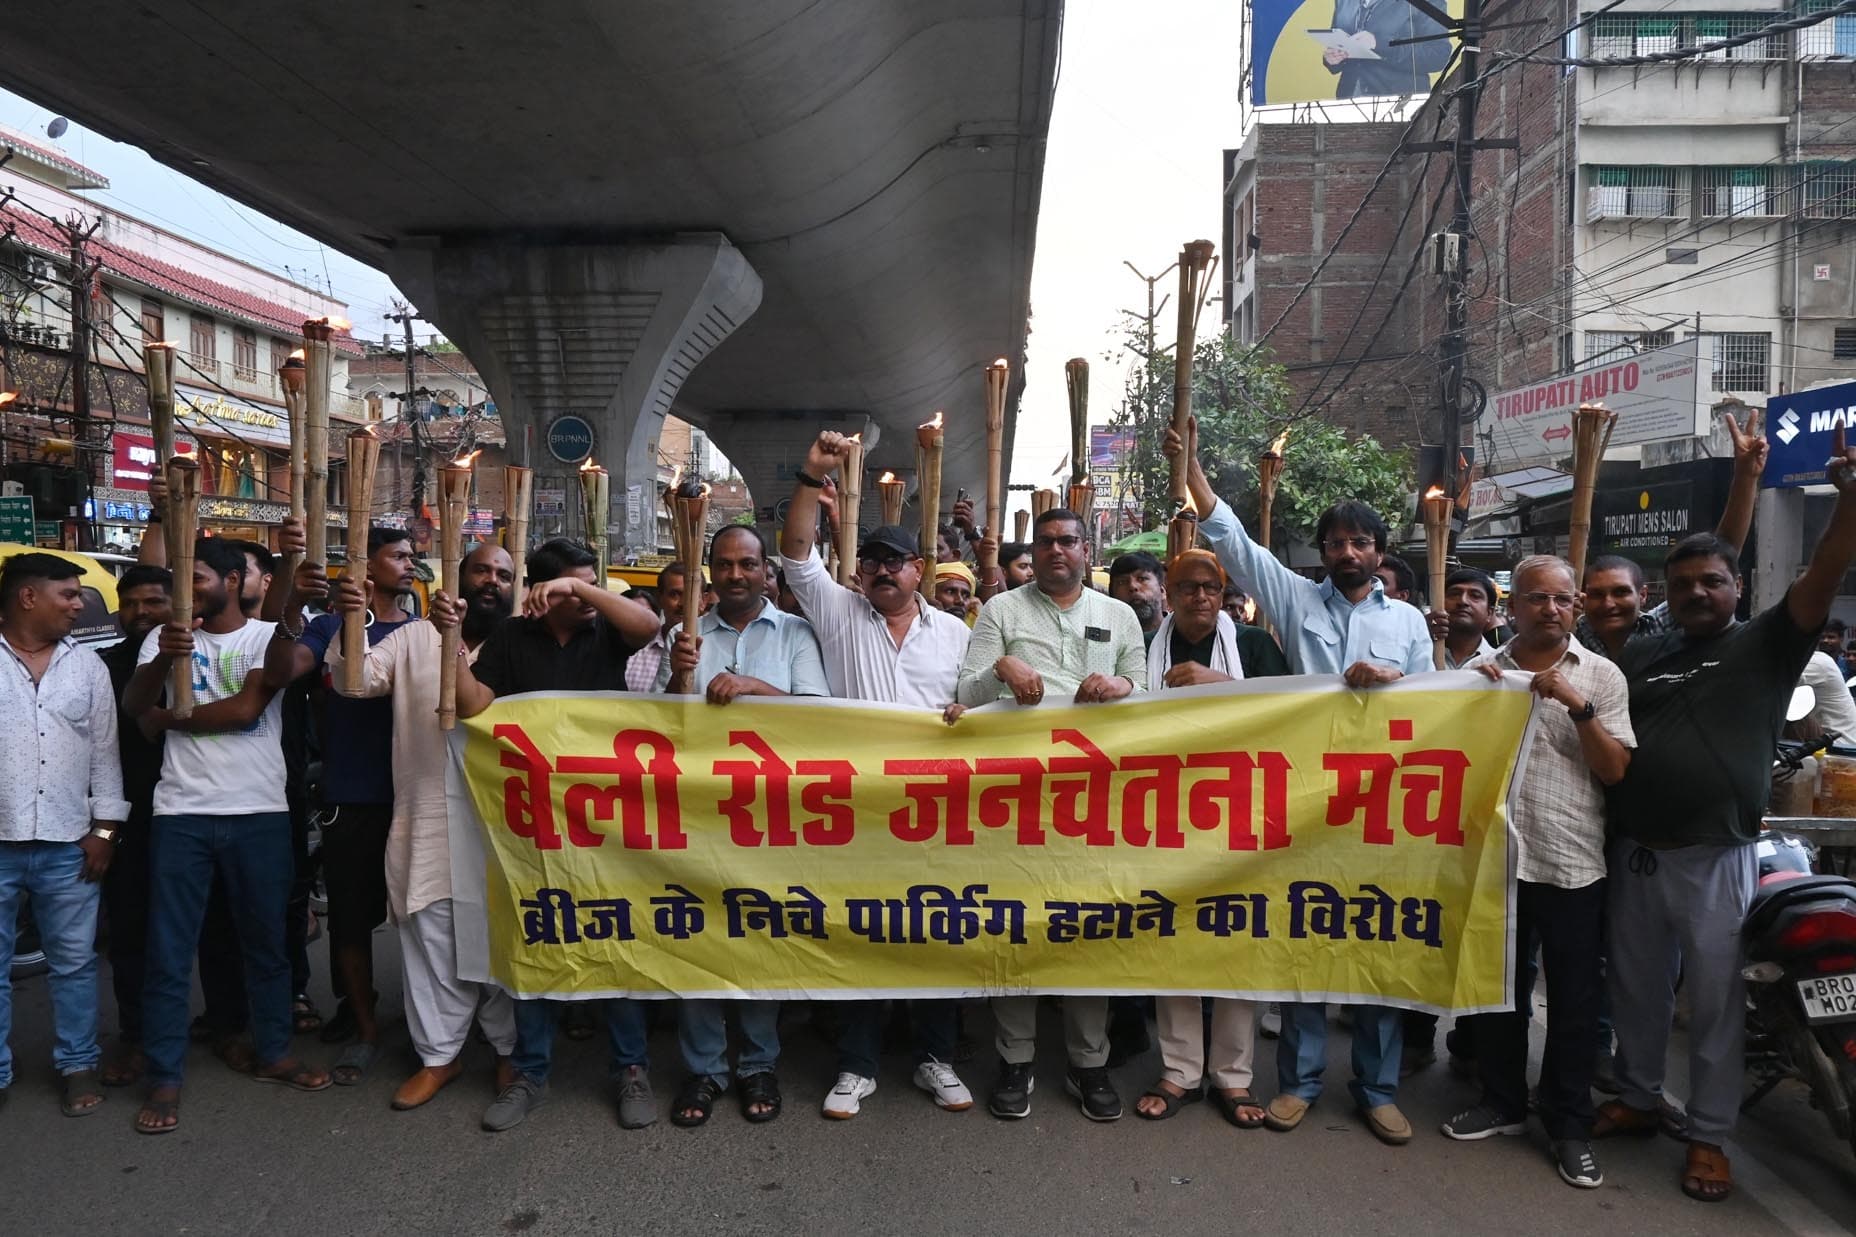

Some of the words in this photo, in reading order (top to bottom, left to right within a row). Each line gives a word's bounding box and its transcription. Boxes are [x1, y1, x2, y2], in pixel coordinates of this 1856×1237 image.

[1496, 378, 1575, 420] TIRUPATI
[1580, 362, 1639, 402] AUTO
[550, 434, 590, 444] BRPNNL
[1605, 513, 1637, 535] TIRUPATI
[1638, 511, 1659, 534] MENS
[1661, 508, 1688, 532] SALON
[1620, 538, 1629, 547] AIR
[1630, 535, 1669, 547] CONDITIONED
[493, 724, 687, 850] बेली
[712, 730, 858, 847] रोड
[884, 728, 1292, 851] जनचेतना
[1323, 719, 1471, 846] मंच
[520, 888, 635, 946] ब्रीज
[650, 884, 704, 940] के
[722, 885, 829, 940] निचे
[1044, 890, 1177, 943] हटाने
[1196, 893, 1269, 938] का
[1288, 880, 1443, 948] विरोध
